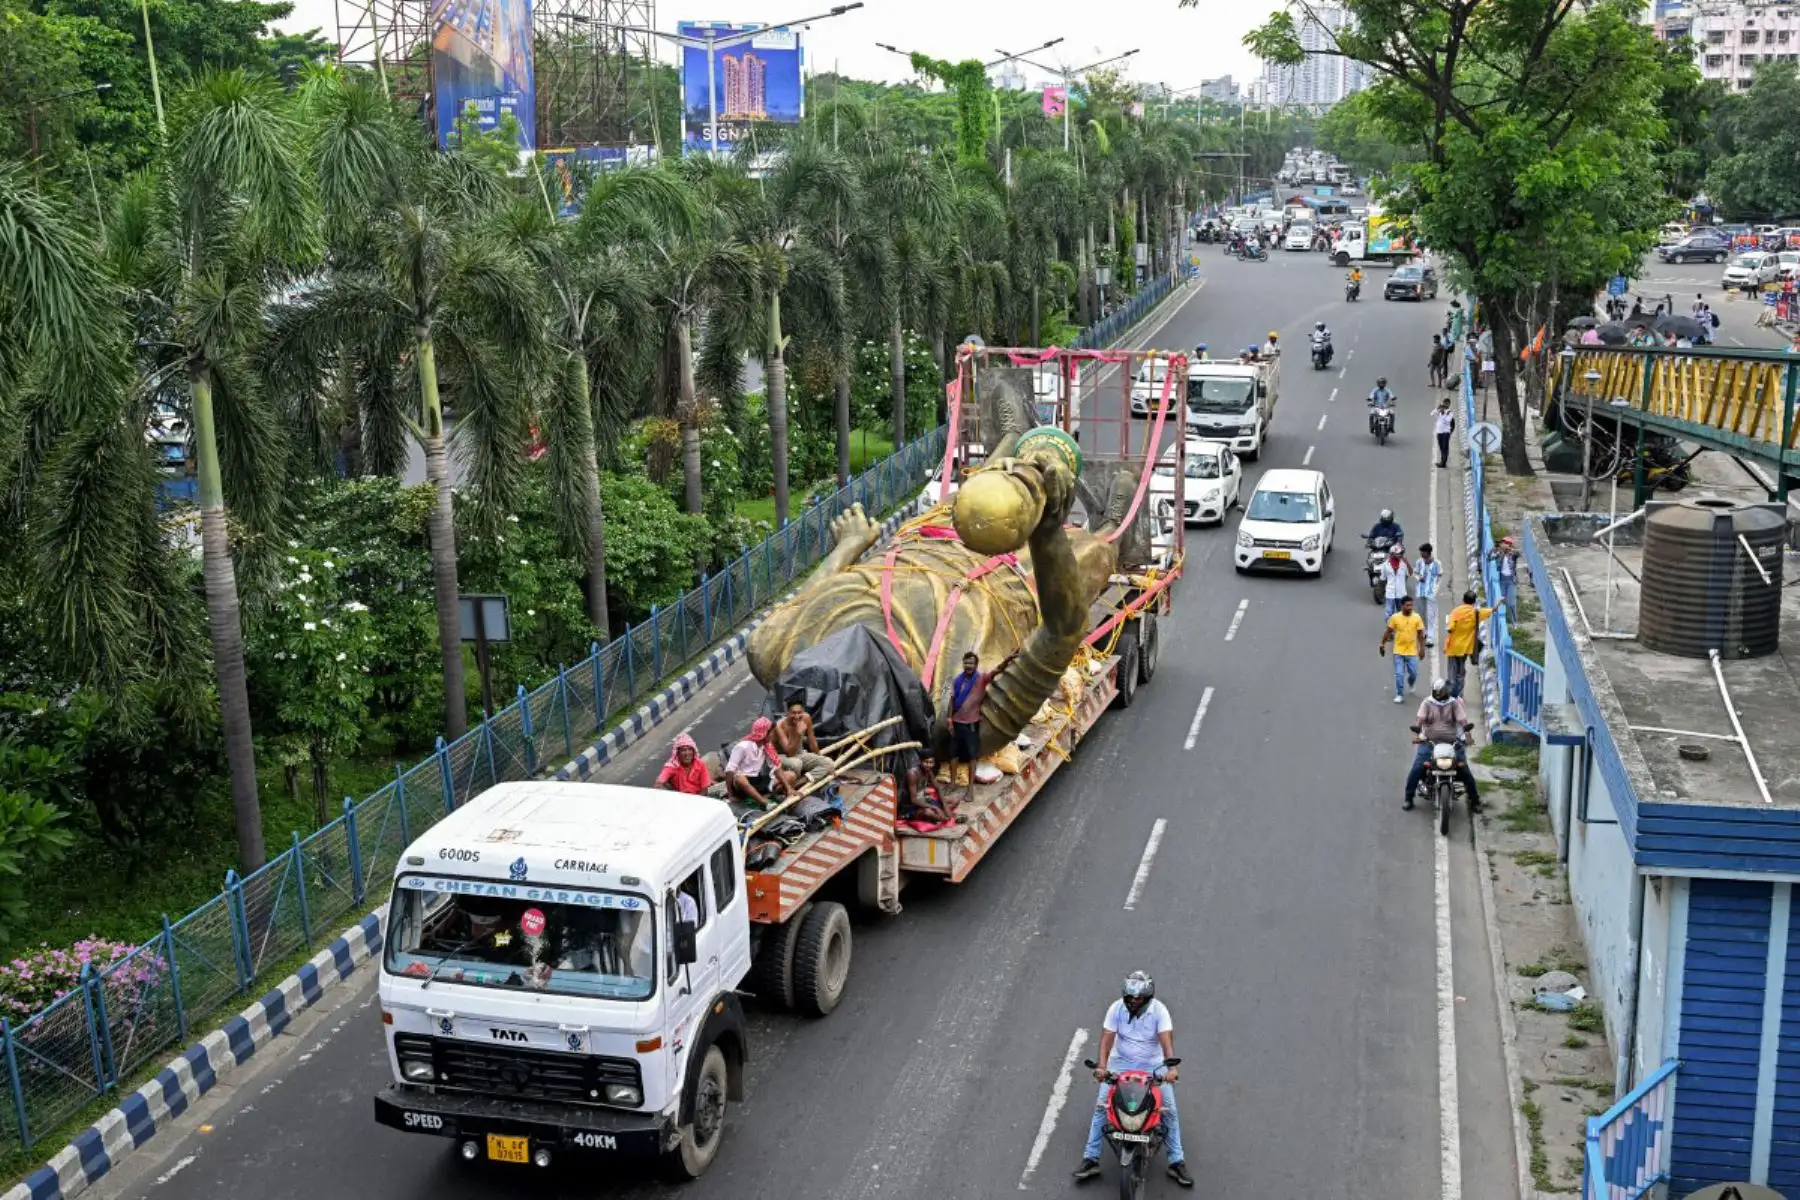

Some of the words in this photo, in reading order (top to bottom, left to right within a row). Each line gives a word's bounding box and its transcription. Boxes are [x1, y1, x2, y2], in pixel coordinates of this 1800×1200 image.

[438, 848, 481, 862] GOODS
[553, 858, 608, 874] CARRIAGE
[433, 880, 517, 897] CHETAN
[526, 889, 613, 907] GARAGE
[489, 1028, 529, 1042] TATA
[403, 1111, 443, 1129] SPEED
[573, 1131, 617, 1150] 40KM
